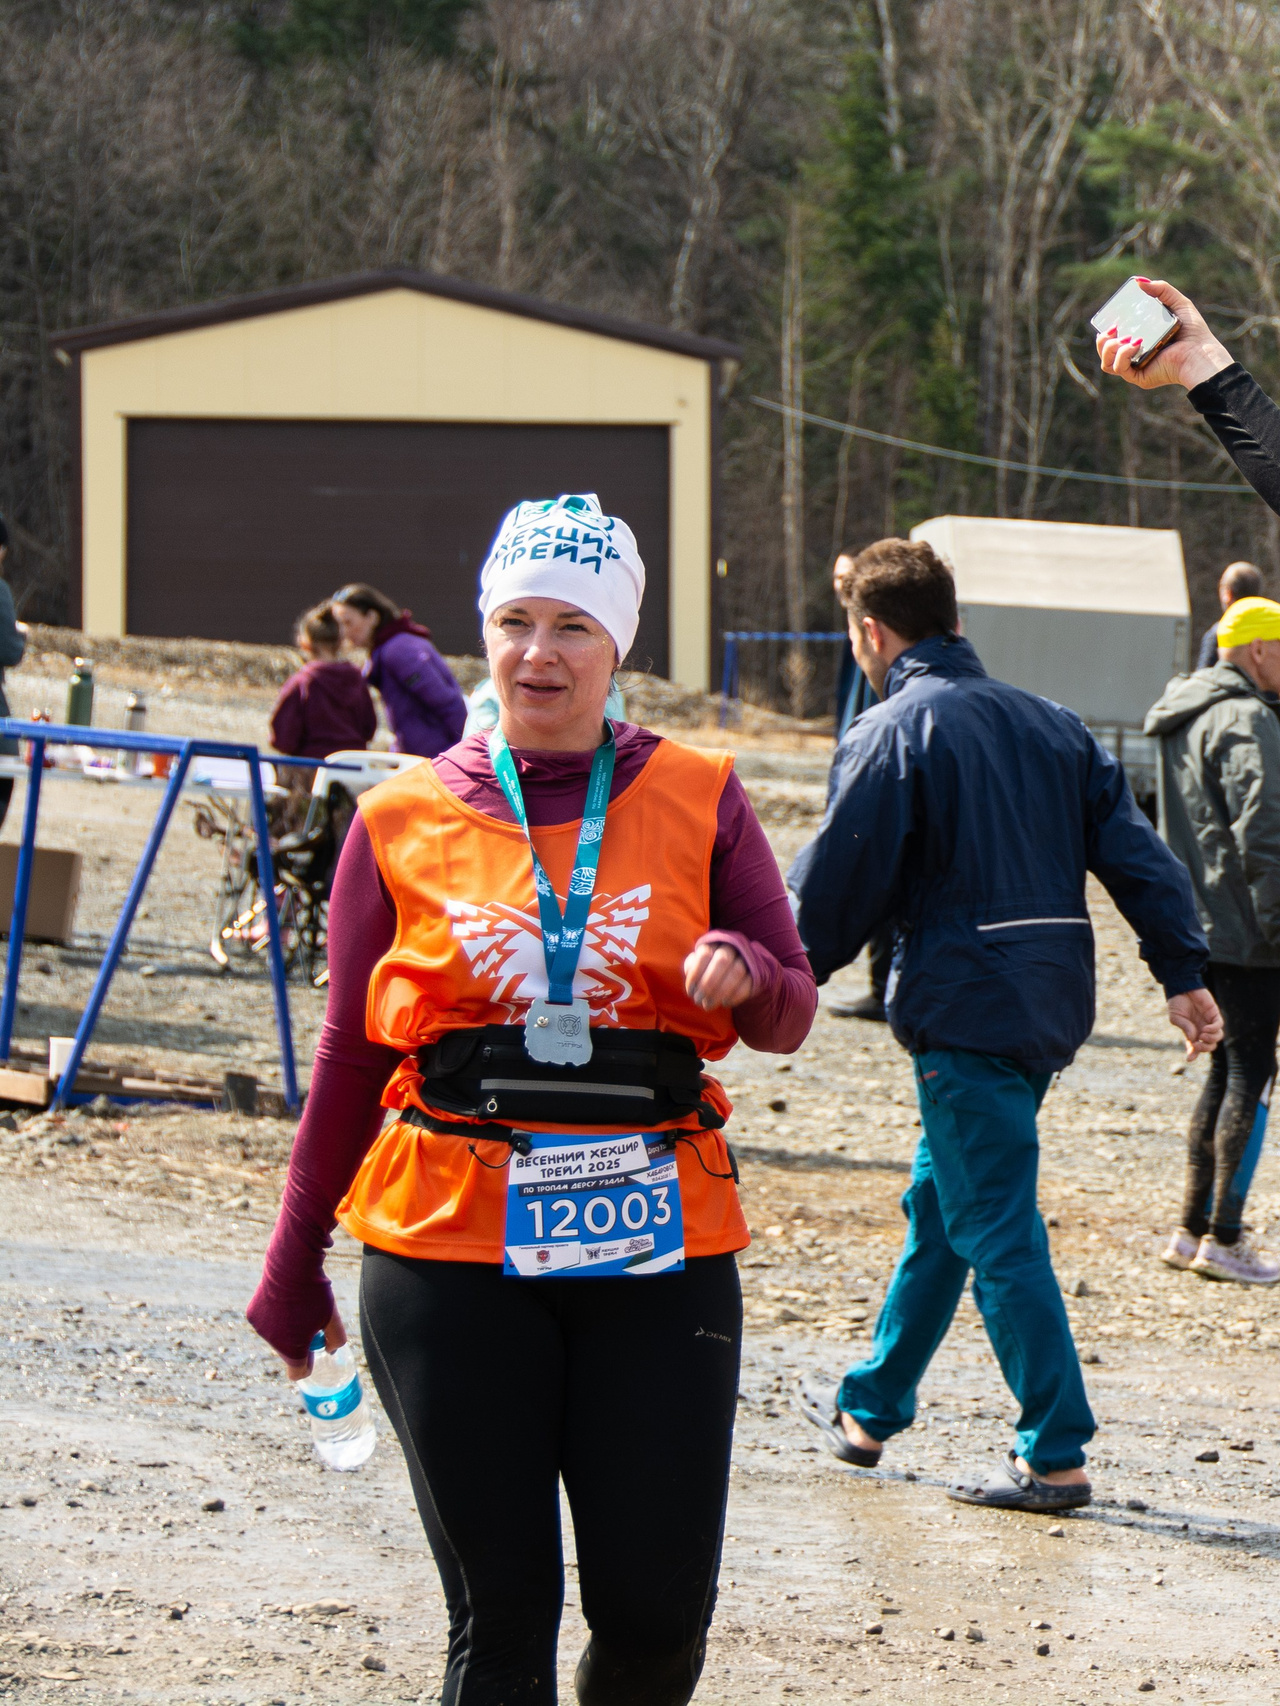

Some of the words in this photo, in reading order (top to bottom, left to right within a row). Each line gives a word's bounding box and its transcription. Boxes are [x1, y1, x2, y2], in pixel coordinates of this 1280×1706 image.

[516, 1151, 585, 1168] ВЕСЕННИЙ
[590, 1141, 639, 1159] ХЕХЦИР
[540, 1164, 583, 1178] ТРЕЙЛ
[588, 1158, 621, 1173] 2025
[537, 1184, 568, 1193] ТРОПАМ
[571, 1180, 597, 1190] ДЕРСУ
[598, 1176, 625, 1187] УЗАЛА
[526, 1186, 672, 1239] 12003
